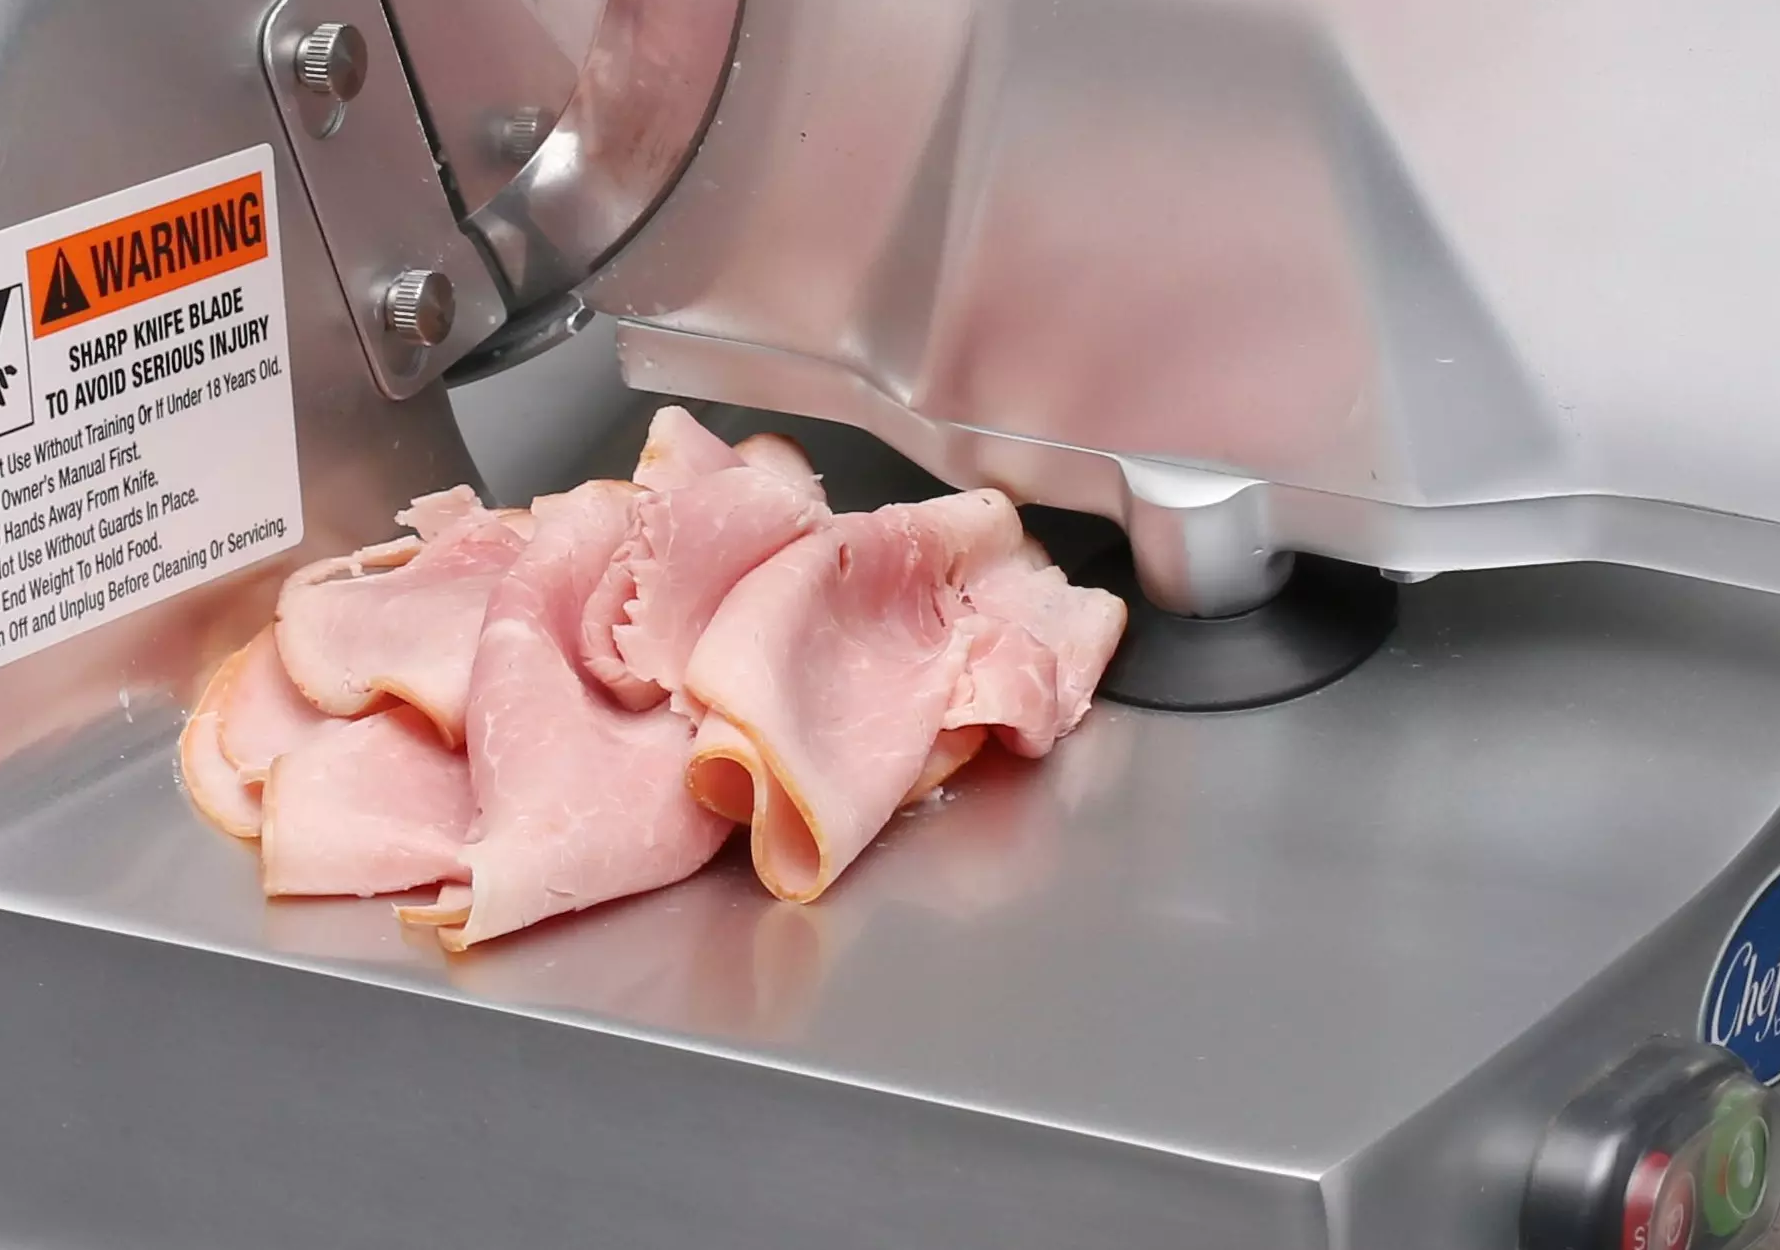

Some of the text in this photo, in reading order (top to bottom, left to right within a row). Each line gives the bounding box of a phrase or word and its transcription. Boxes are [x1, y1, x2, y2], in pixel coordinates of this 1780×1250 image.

[90, 192, 262, 298] WARNING
[45, 314, 270, 419] TO AVOID SERIOUS INJURY
[69, 286, 244, 372] SHARP KNIFE BLADE
[7, 452, 31, 475] Use
[33, 429, 83, 465] Without
[85, 414, 134, 445] Training
[138, 404, 153, 426] Or
[155, 397, 164, 420] If
[166, 387, 202, 415] Under
[206, 377, 221, 400] 18
[223, 368, 256, 394] Years
[259, 355, 282, 381] Old.
[1, 474, 55, 511] Owner's
[58, 452, 106, 490] Manual
[108, 441, 141, 470] First.
[4, 512, 45, 544] Hands
[49, 498, 83, 528] Away
[86, 484, 120, 512] From
[123, 468, 159, 498] Knife.
[1, 583, 26, 613] End
[28, 564, 75, 601] Weight
[77, 559, 92, 582] To
[95, 544, 124, 574] Hold
[128, 531, 162, 562] Food.
[18, 548, 43, 572] Use
[45, 523, 96, 561] Without
[98, 507, 143, 540] Guards
[146, 500, 159, 522] In
[162, 487, 199, 516] Place.
[9, 615, 28, 643] Off
[32, 605, 56, 634] and
[59, 589, 105, 622] Unplug
[108, 574, 149, 602] Before
[153, 548, 207, 583] Cleaning
[210, 539, 225, 561] Or
[227, 516, 288, 554] Servicing.
